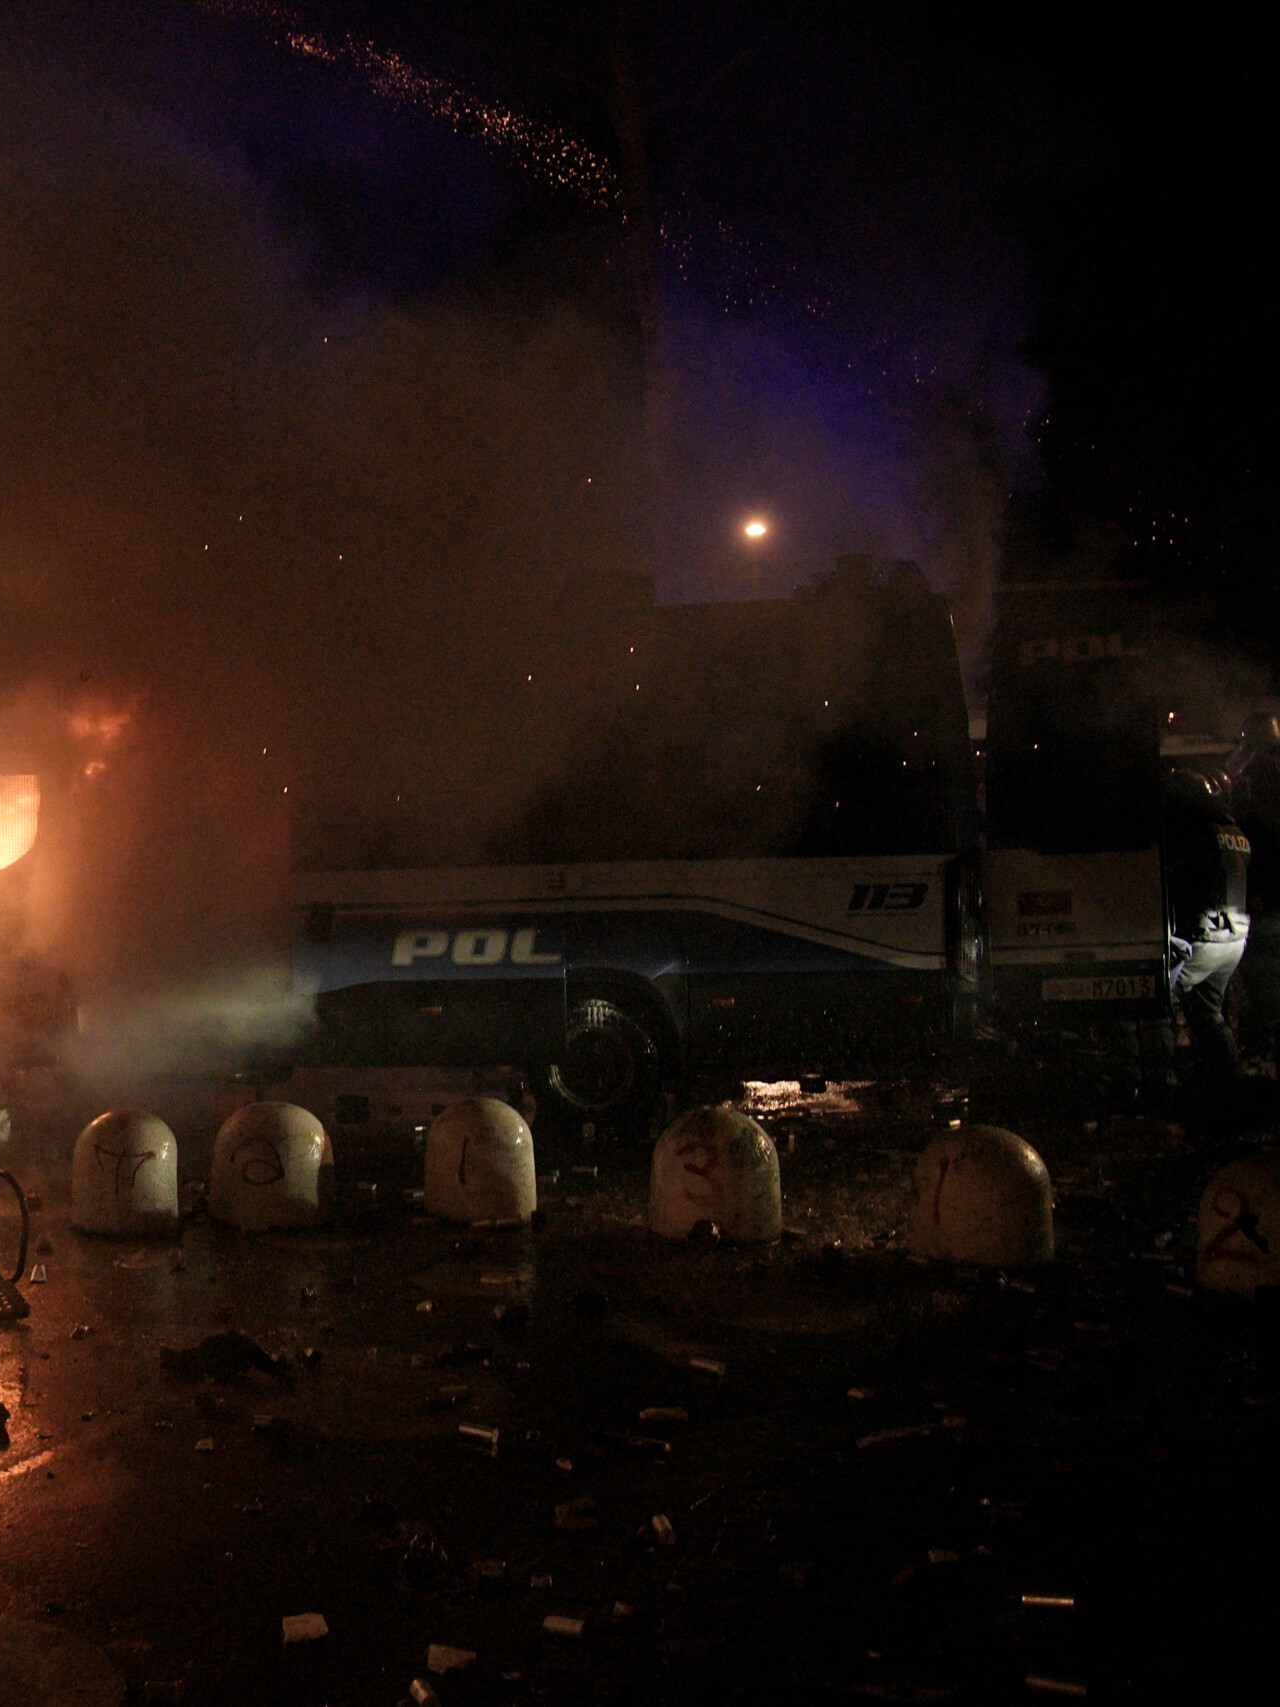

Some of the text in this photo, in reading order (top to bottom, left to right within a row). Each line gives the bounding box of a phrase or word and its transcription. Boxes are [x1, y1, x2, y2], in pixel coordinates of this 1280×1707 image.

[848, 883, 929, 910] 113
[391, 928, 562, 966] POL
[1204, 1188, 1261, 1263] 2
